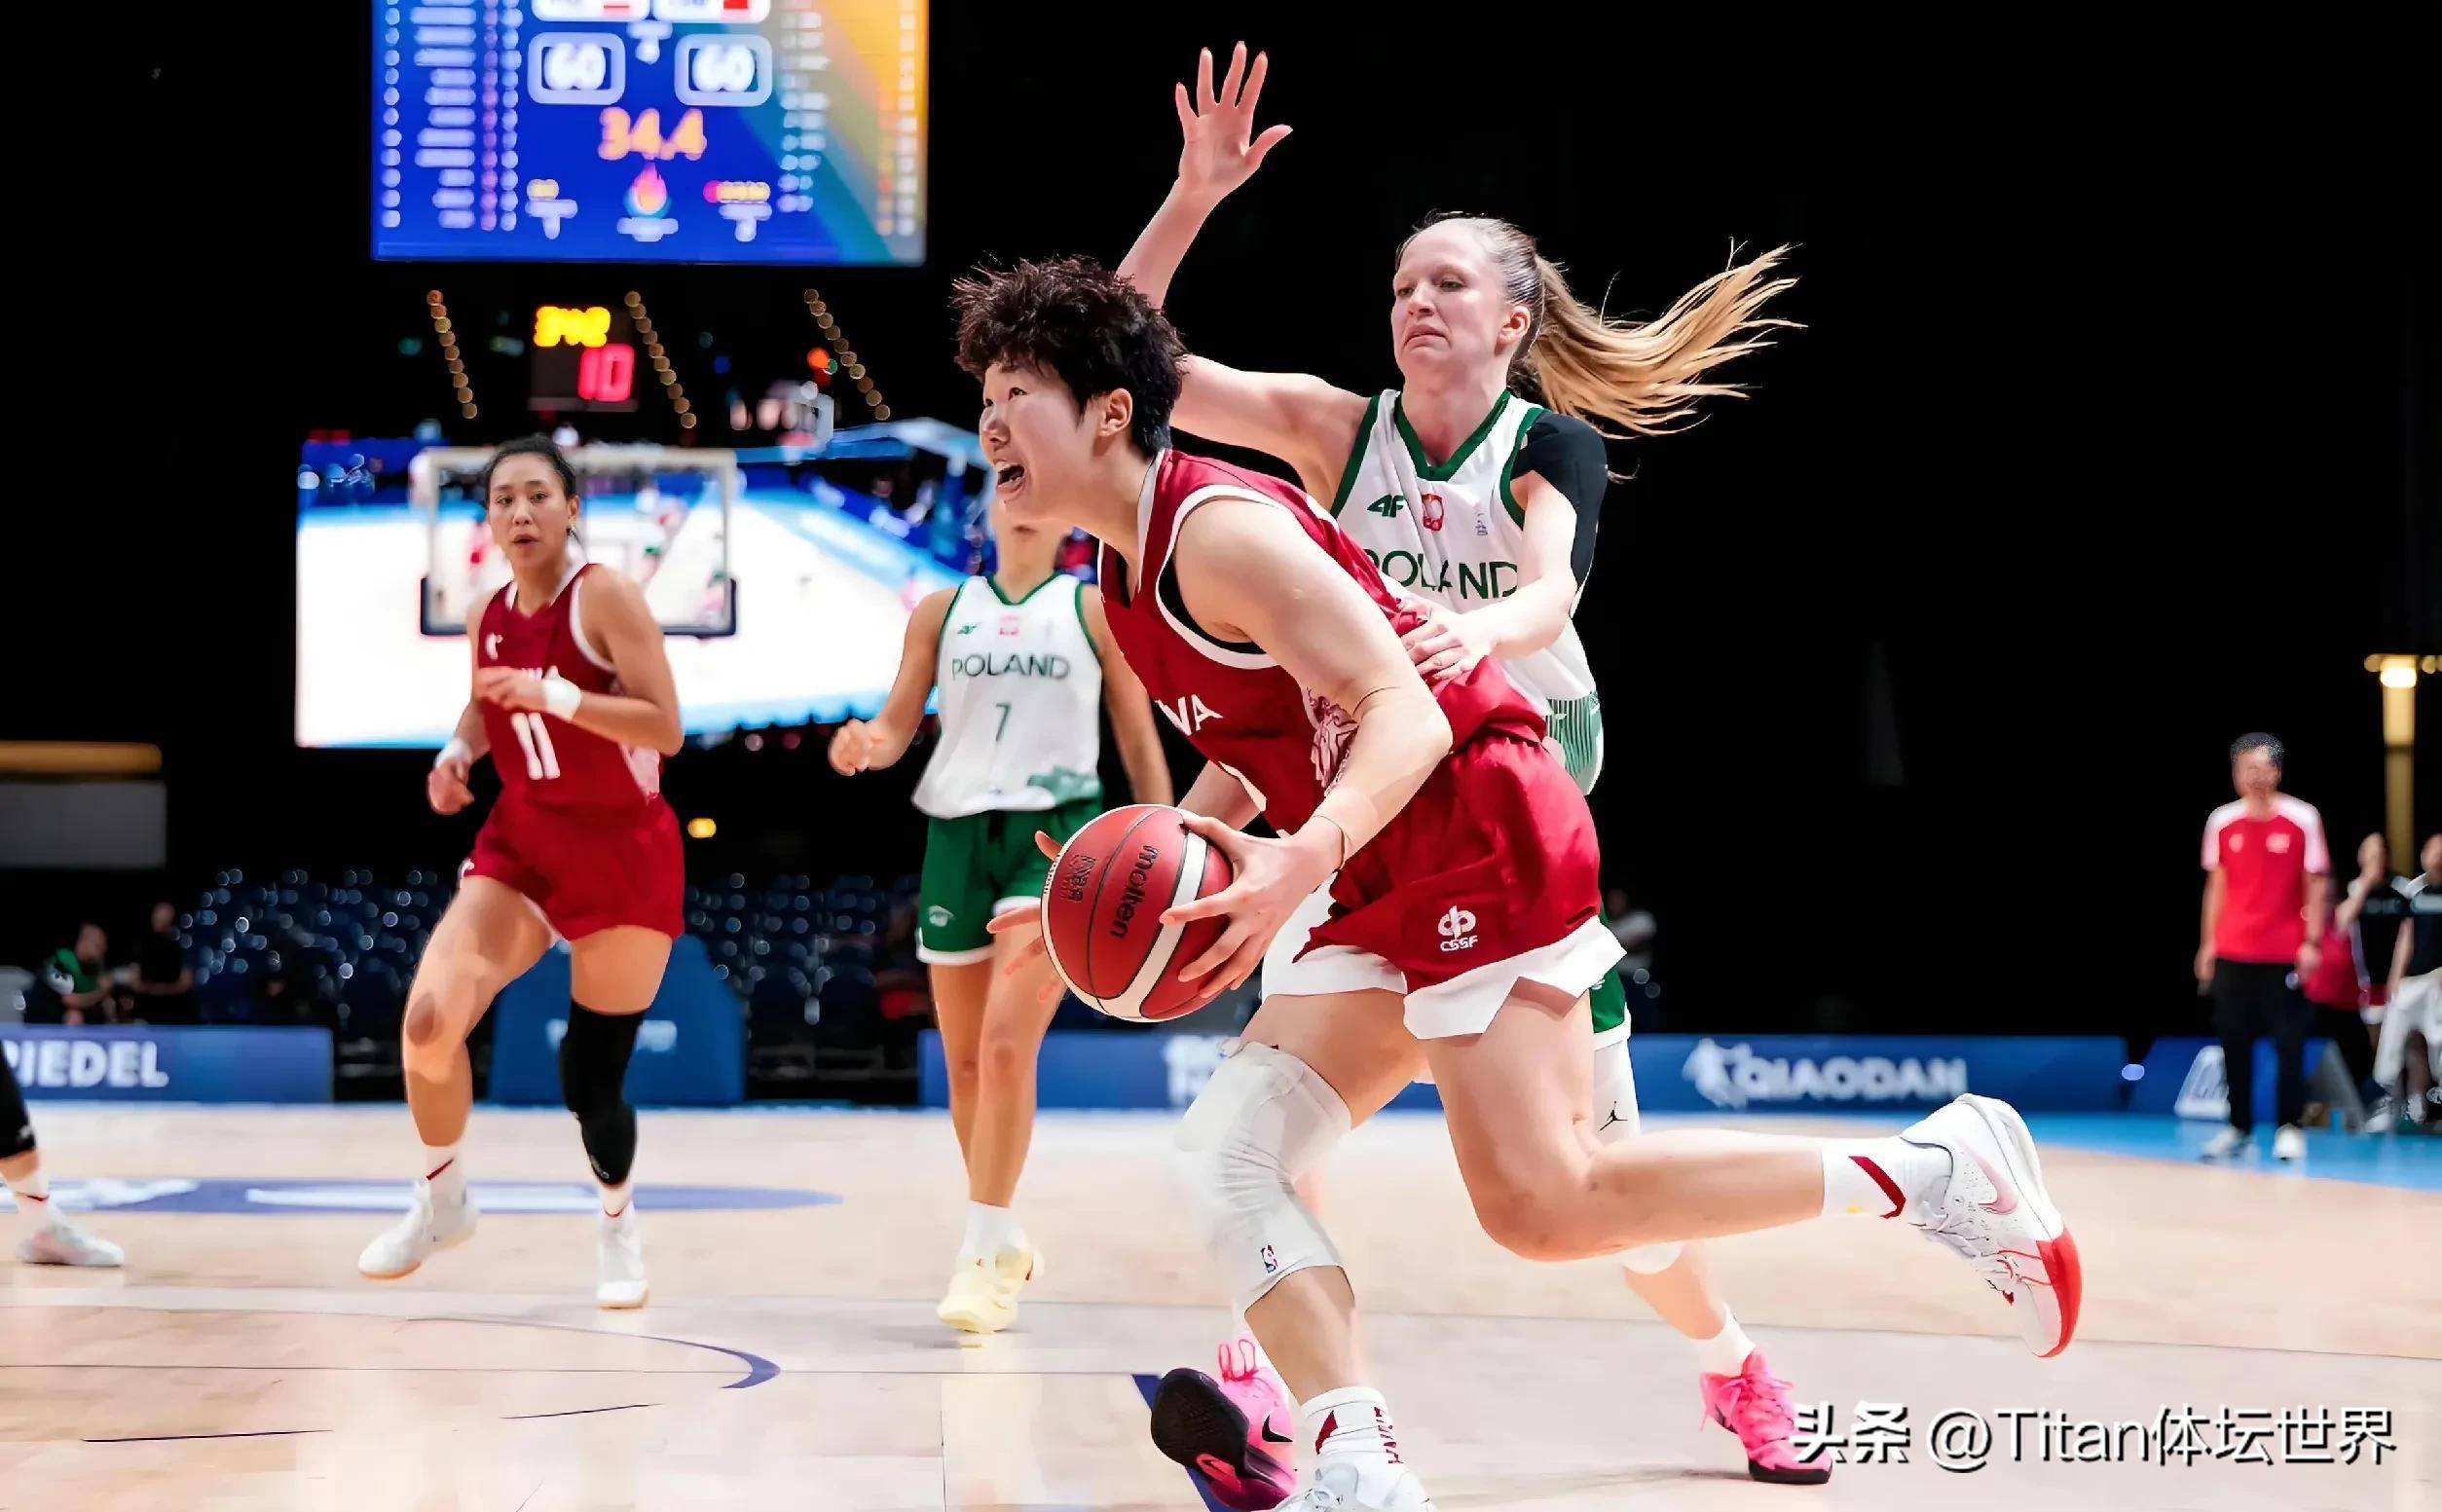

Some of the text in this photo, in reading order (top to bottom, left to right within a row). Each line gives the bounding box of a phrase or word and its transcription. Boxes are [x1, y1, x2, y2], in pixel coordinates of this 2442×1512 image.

[598, 107, 707, 161] 34.4
[578, 344, 635, 402] 10
[951, 651, 1071, 681] POLAND
[510, 712, 561, 780] 11
[995, 702, 1013, 743] 7
[1109, 844, 1160, 939] molten
[1439, 935, 1479, 952] CSSF
